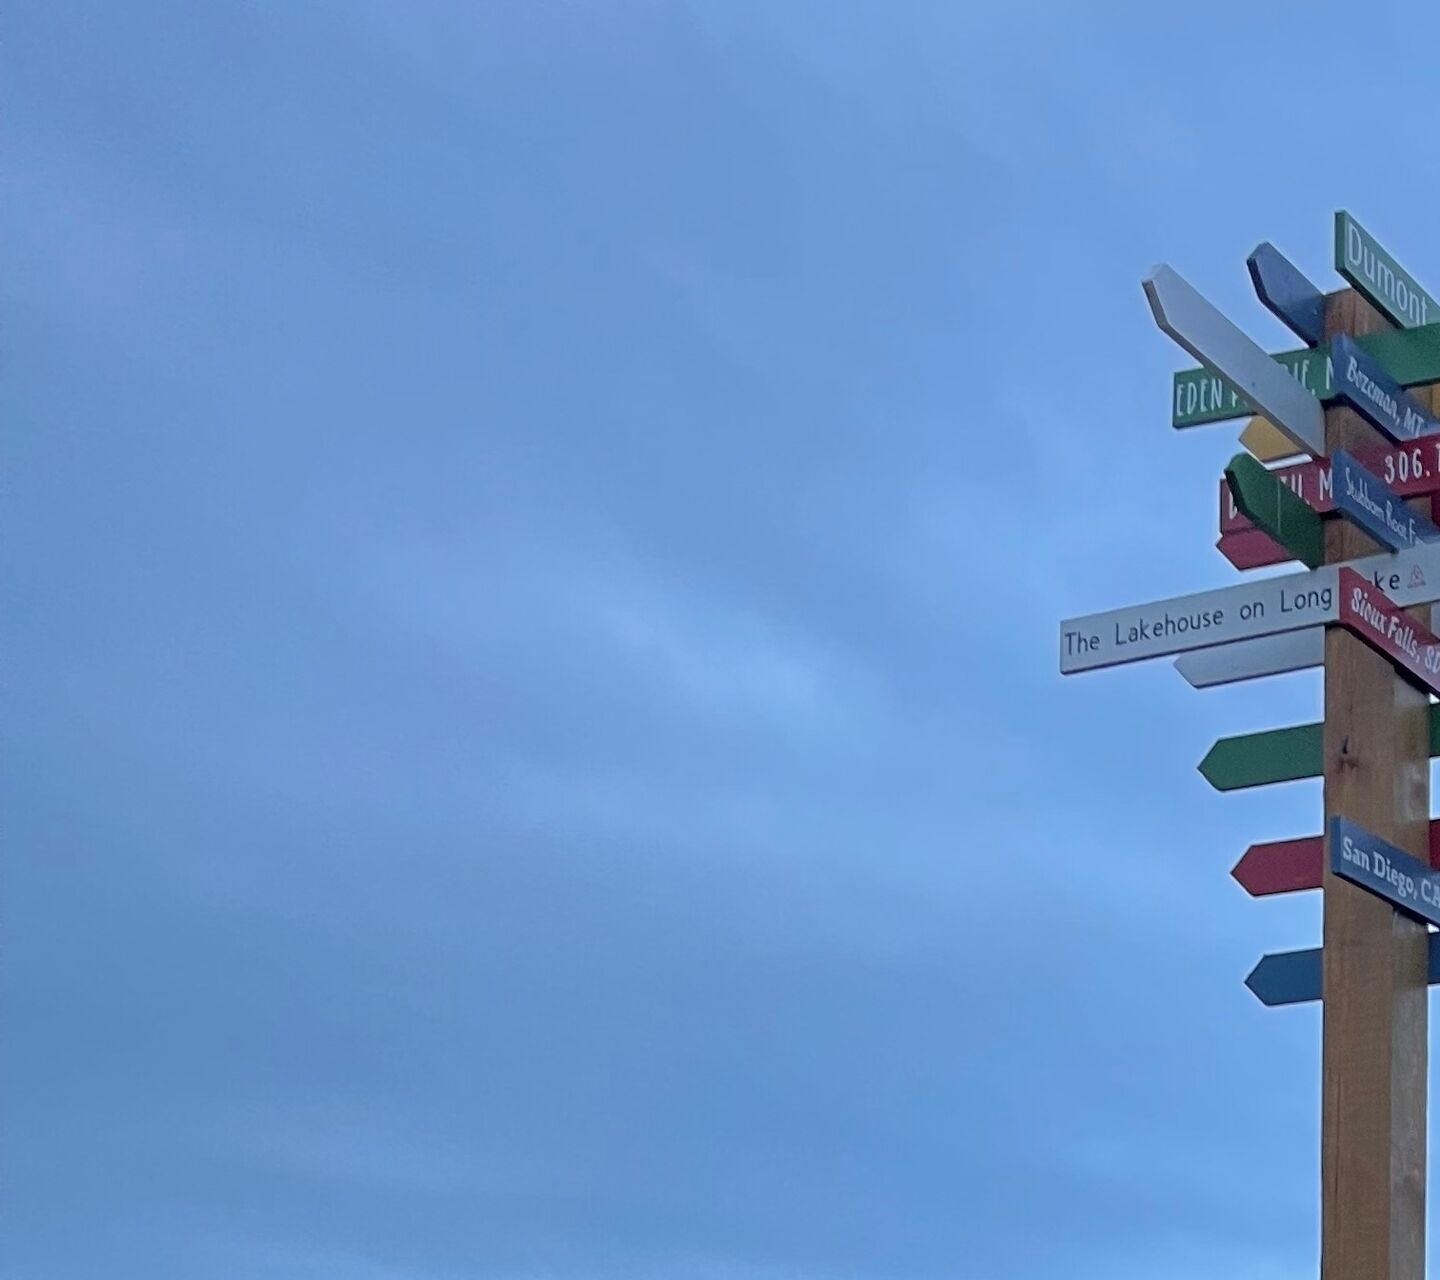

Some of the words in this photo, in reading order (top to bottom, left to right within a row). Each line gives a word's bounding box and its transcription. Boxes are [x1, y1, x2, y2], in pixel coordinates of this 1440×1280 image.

[1348, 222, 1428, 326] Dumont
[1175, 379, 1223, 417] EDEN
[1403, 407, 1425, 437] MT
[1064, 631, 1101, 656] The
[1115, 605, 1224, 646] Lakehouse
[1239, 600, 1265, 620] on
[1280, 586, 1333, 614] Long
[1368, 570, 1401, 592] ke
[1350, 587, 1388, 634] Sioux
[1342, 836, 1371, 872] San
[1373, 851, 1418, 901] Diego,
